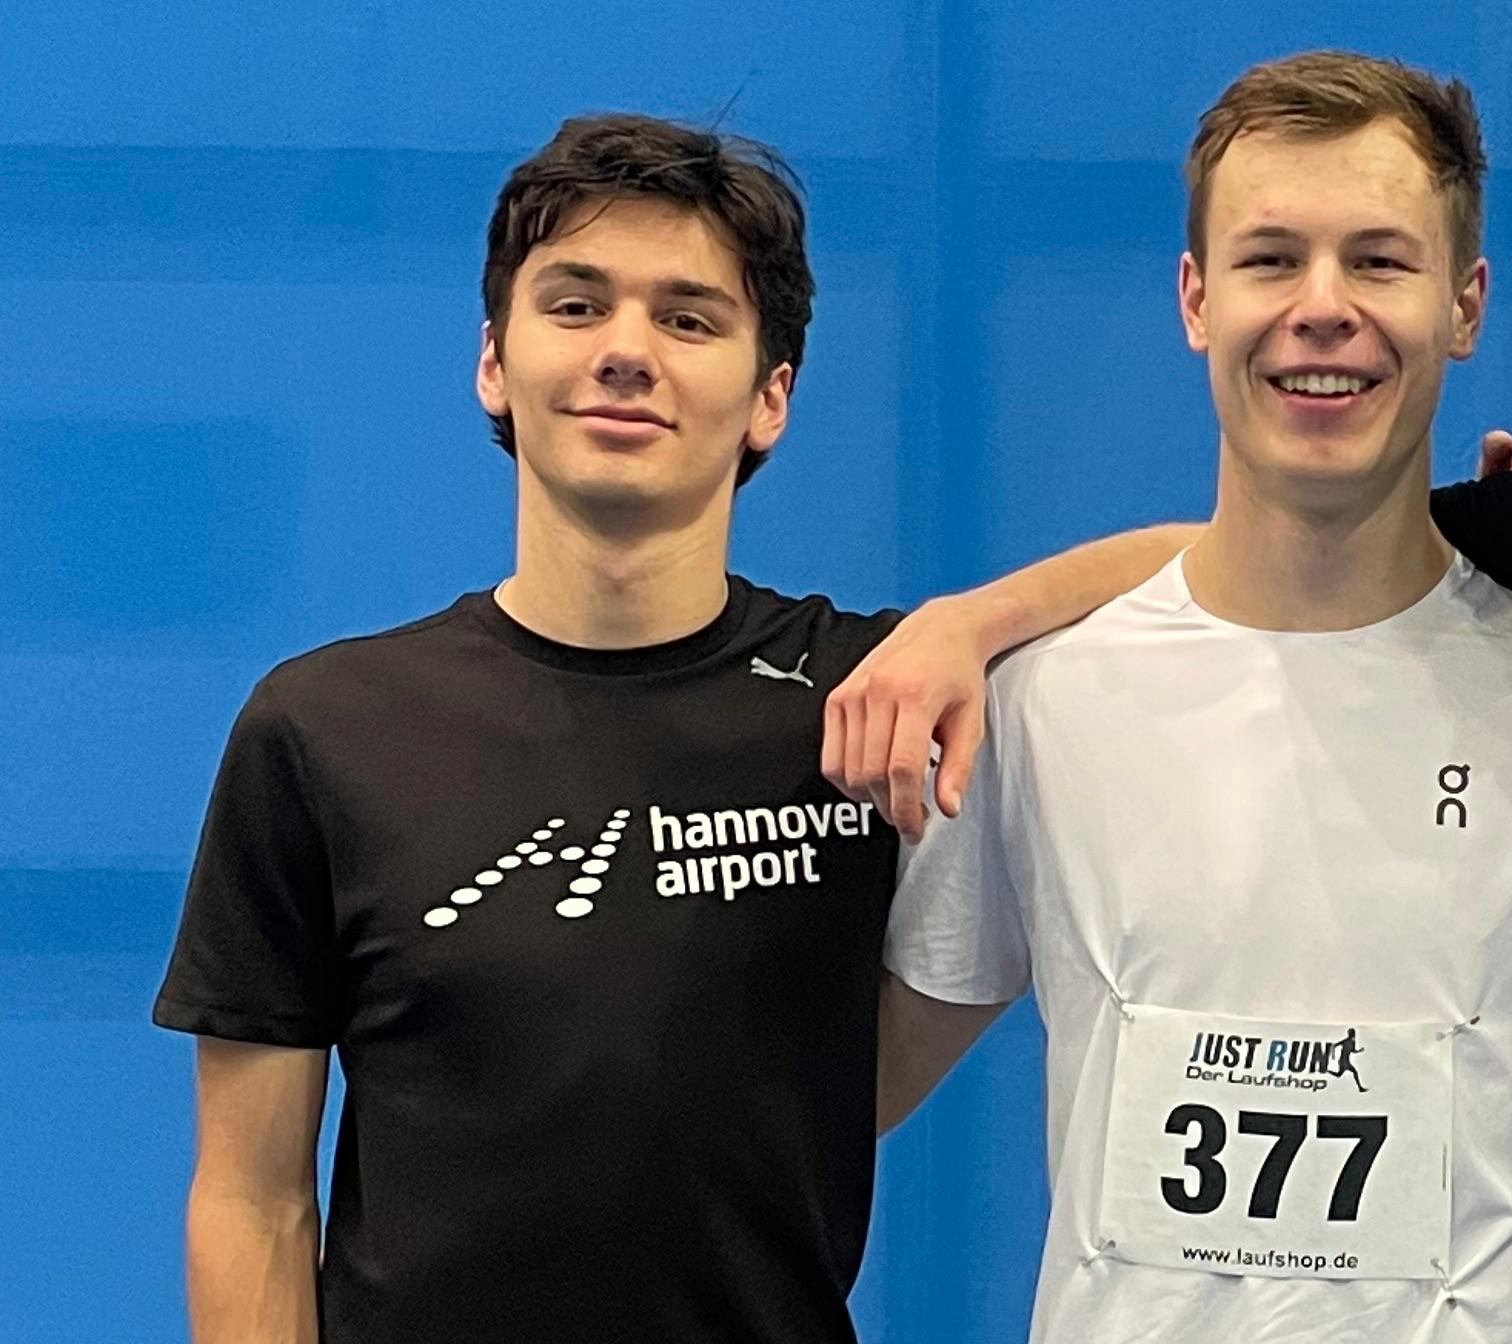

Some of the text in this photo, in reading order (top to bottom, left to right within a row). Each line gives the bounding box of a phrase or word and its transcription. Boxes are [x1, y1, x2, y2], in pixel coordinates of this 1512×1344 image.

[649, 803, 874, 852] hannover
[655, 843, 820, 901] airport
[1190, 1032, 1334, 1075] JUST RUN
[1186, 1067, 1328, 1092] Der Laufshop
[1160, 1103, 1388, 1222] 377
[1183, 1247, 1359, 1272] www.laufshop.de
